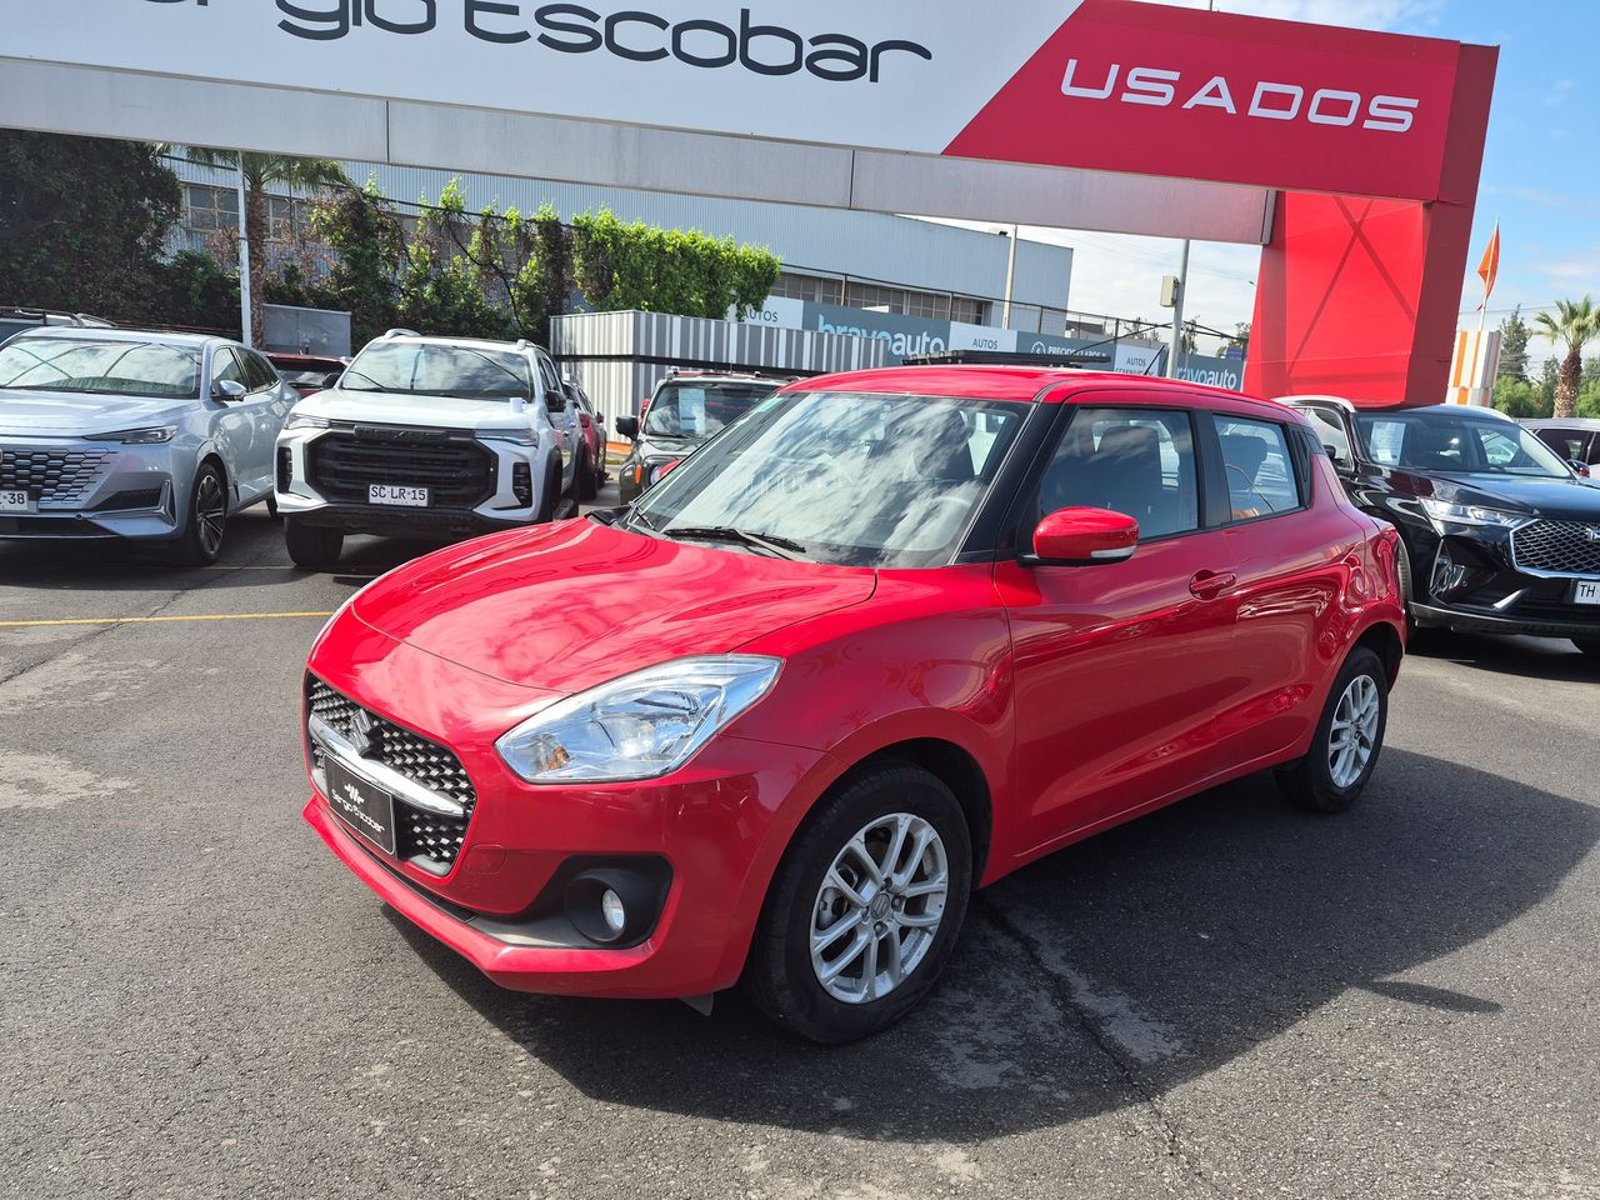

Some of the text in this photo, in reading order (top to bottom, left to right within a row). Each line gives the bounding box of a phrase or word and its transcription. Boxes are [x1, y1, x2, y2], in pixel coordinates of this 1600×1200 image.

[464, 0, 932, 83] Escobar
[1060, 59, 1420, 132] USADOS
[971, 338, 998, 350] AUTOS
[1126, 357, 1147, 367] AUTOS
[1176, 367, 1237, 390] ravoauto
